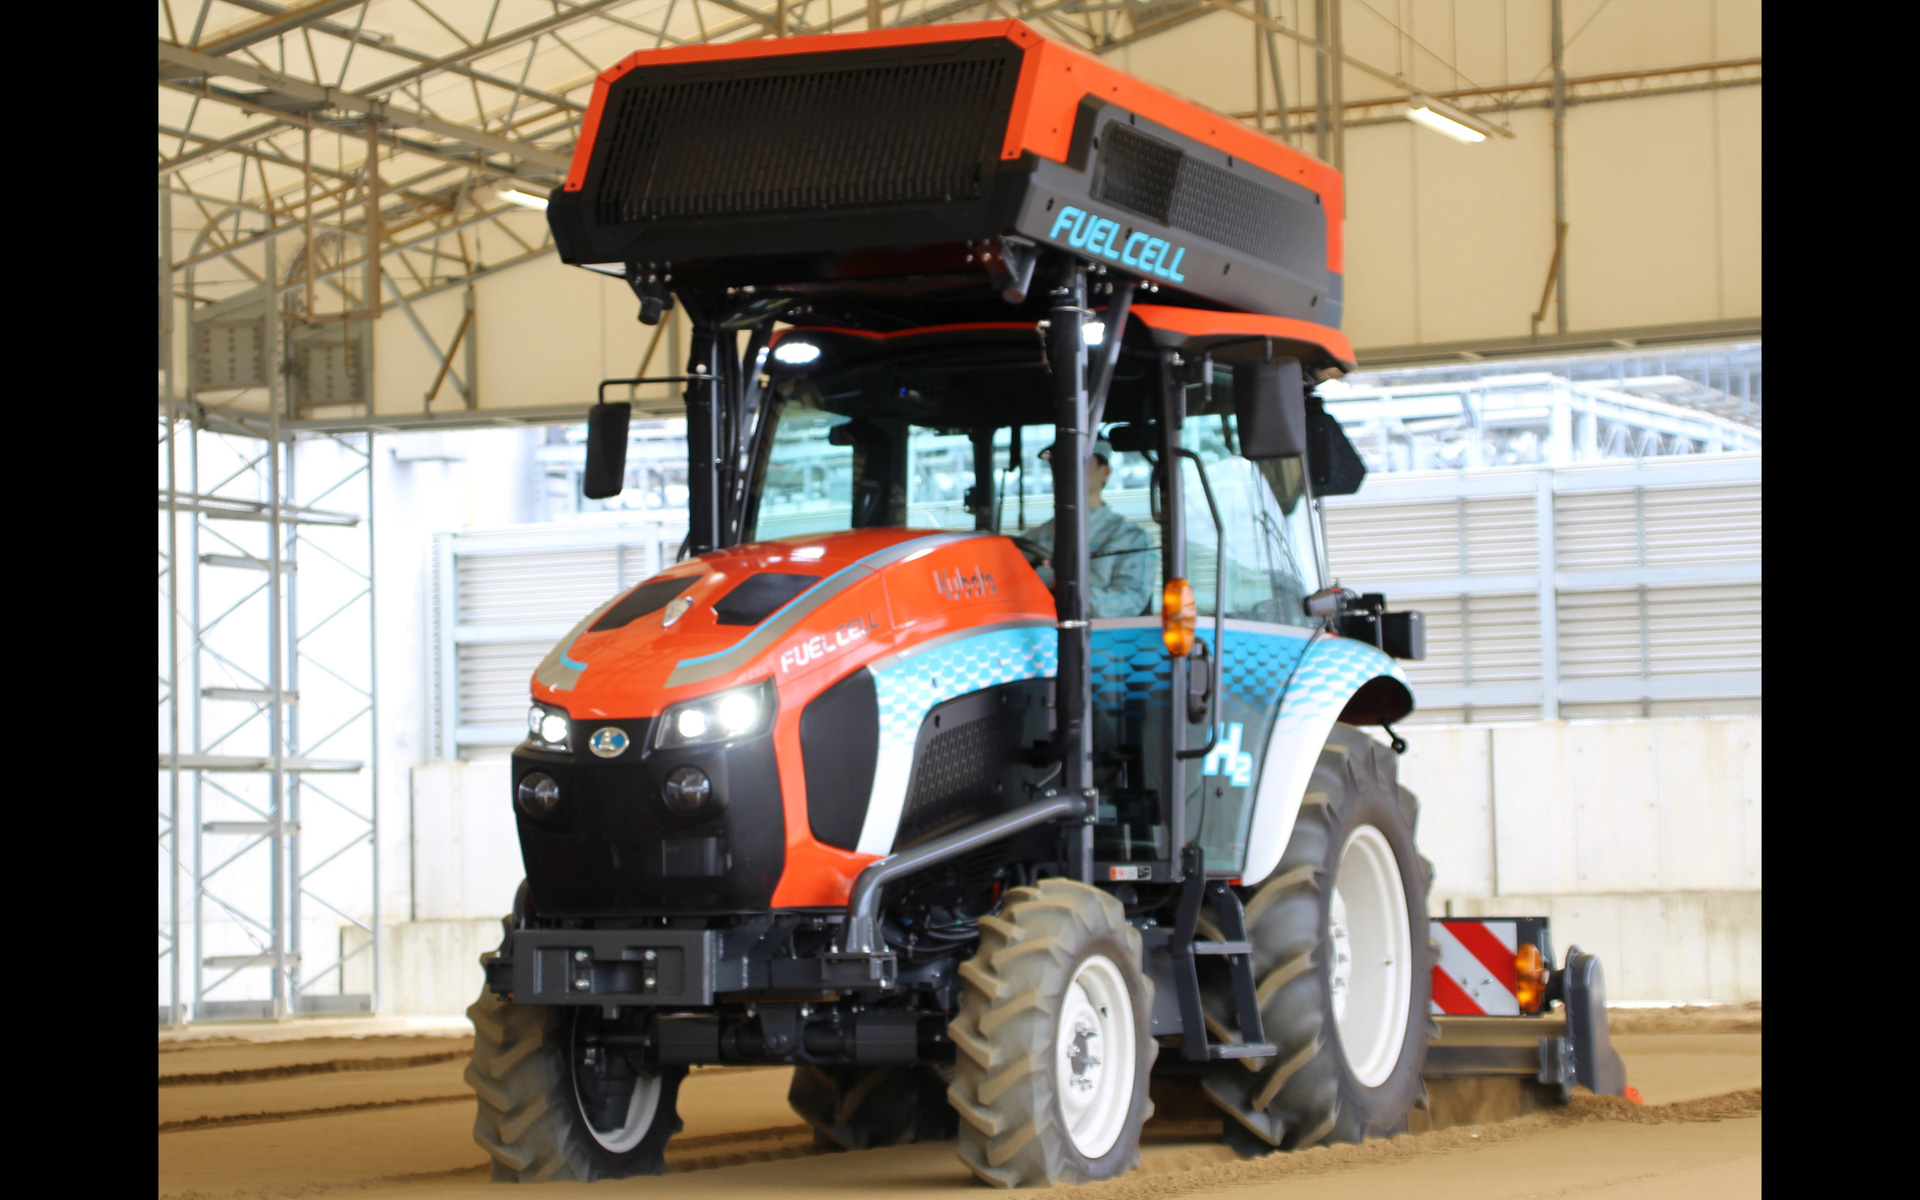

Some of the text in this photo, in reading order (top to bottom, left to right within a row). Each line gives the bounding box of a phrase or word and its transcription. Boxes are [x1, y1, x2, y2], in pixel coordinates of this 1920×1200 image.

[1049, 205, 1186, 284] FUEL CELL
[933, 565, 998, 602] Kubota
[781, 612, 881, 674] FUEL CELL
